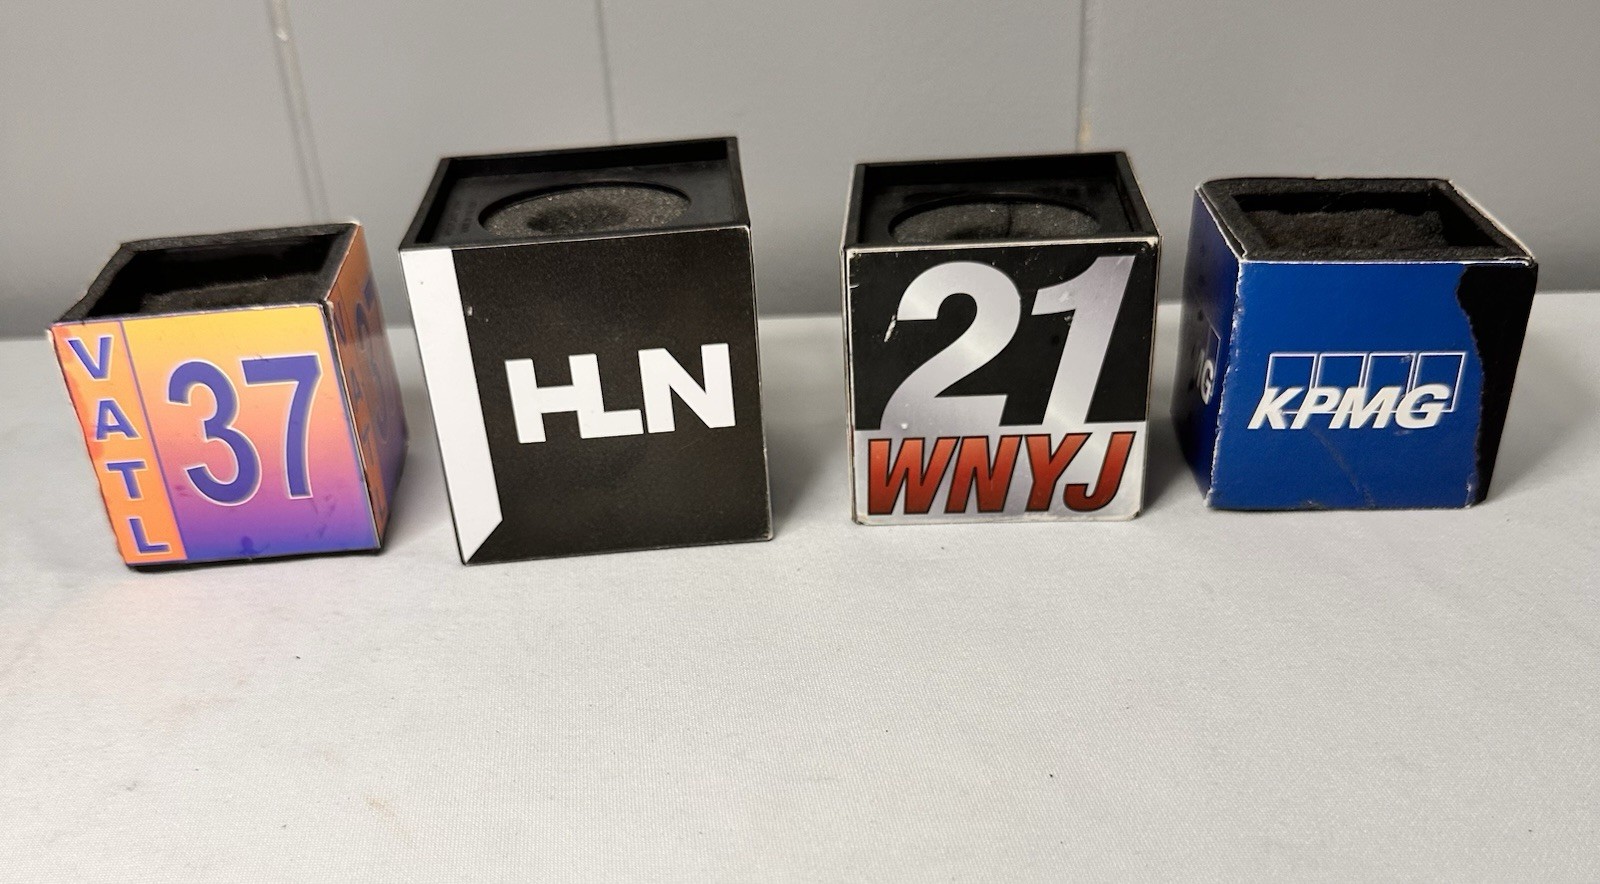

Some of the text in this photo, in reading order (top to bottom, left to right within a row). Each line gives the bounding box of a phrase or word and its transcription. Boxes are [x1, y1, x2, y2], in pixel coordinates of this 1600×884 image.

[504, 342, 736, 444] HLN
[880, 254, 1137, 430] 21
[68, 335, 171, 555] VATL
[166, 353, 324, 507] 37
[1246, 383, 1452, 431] KPMG
[867, 430, 1137, 516] WNYJ
